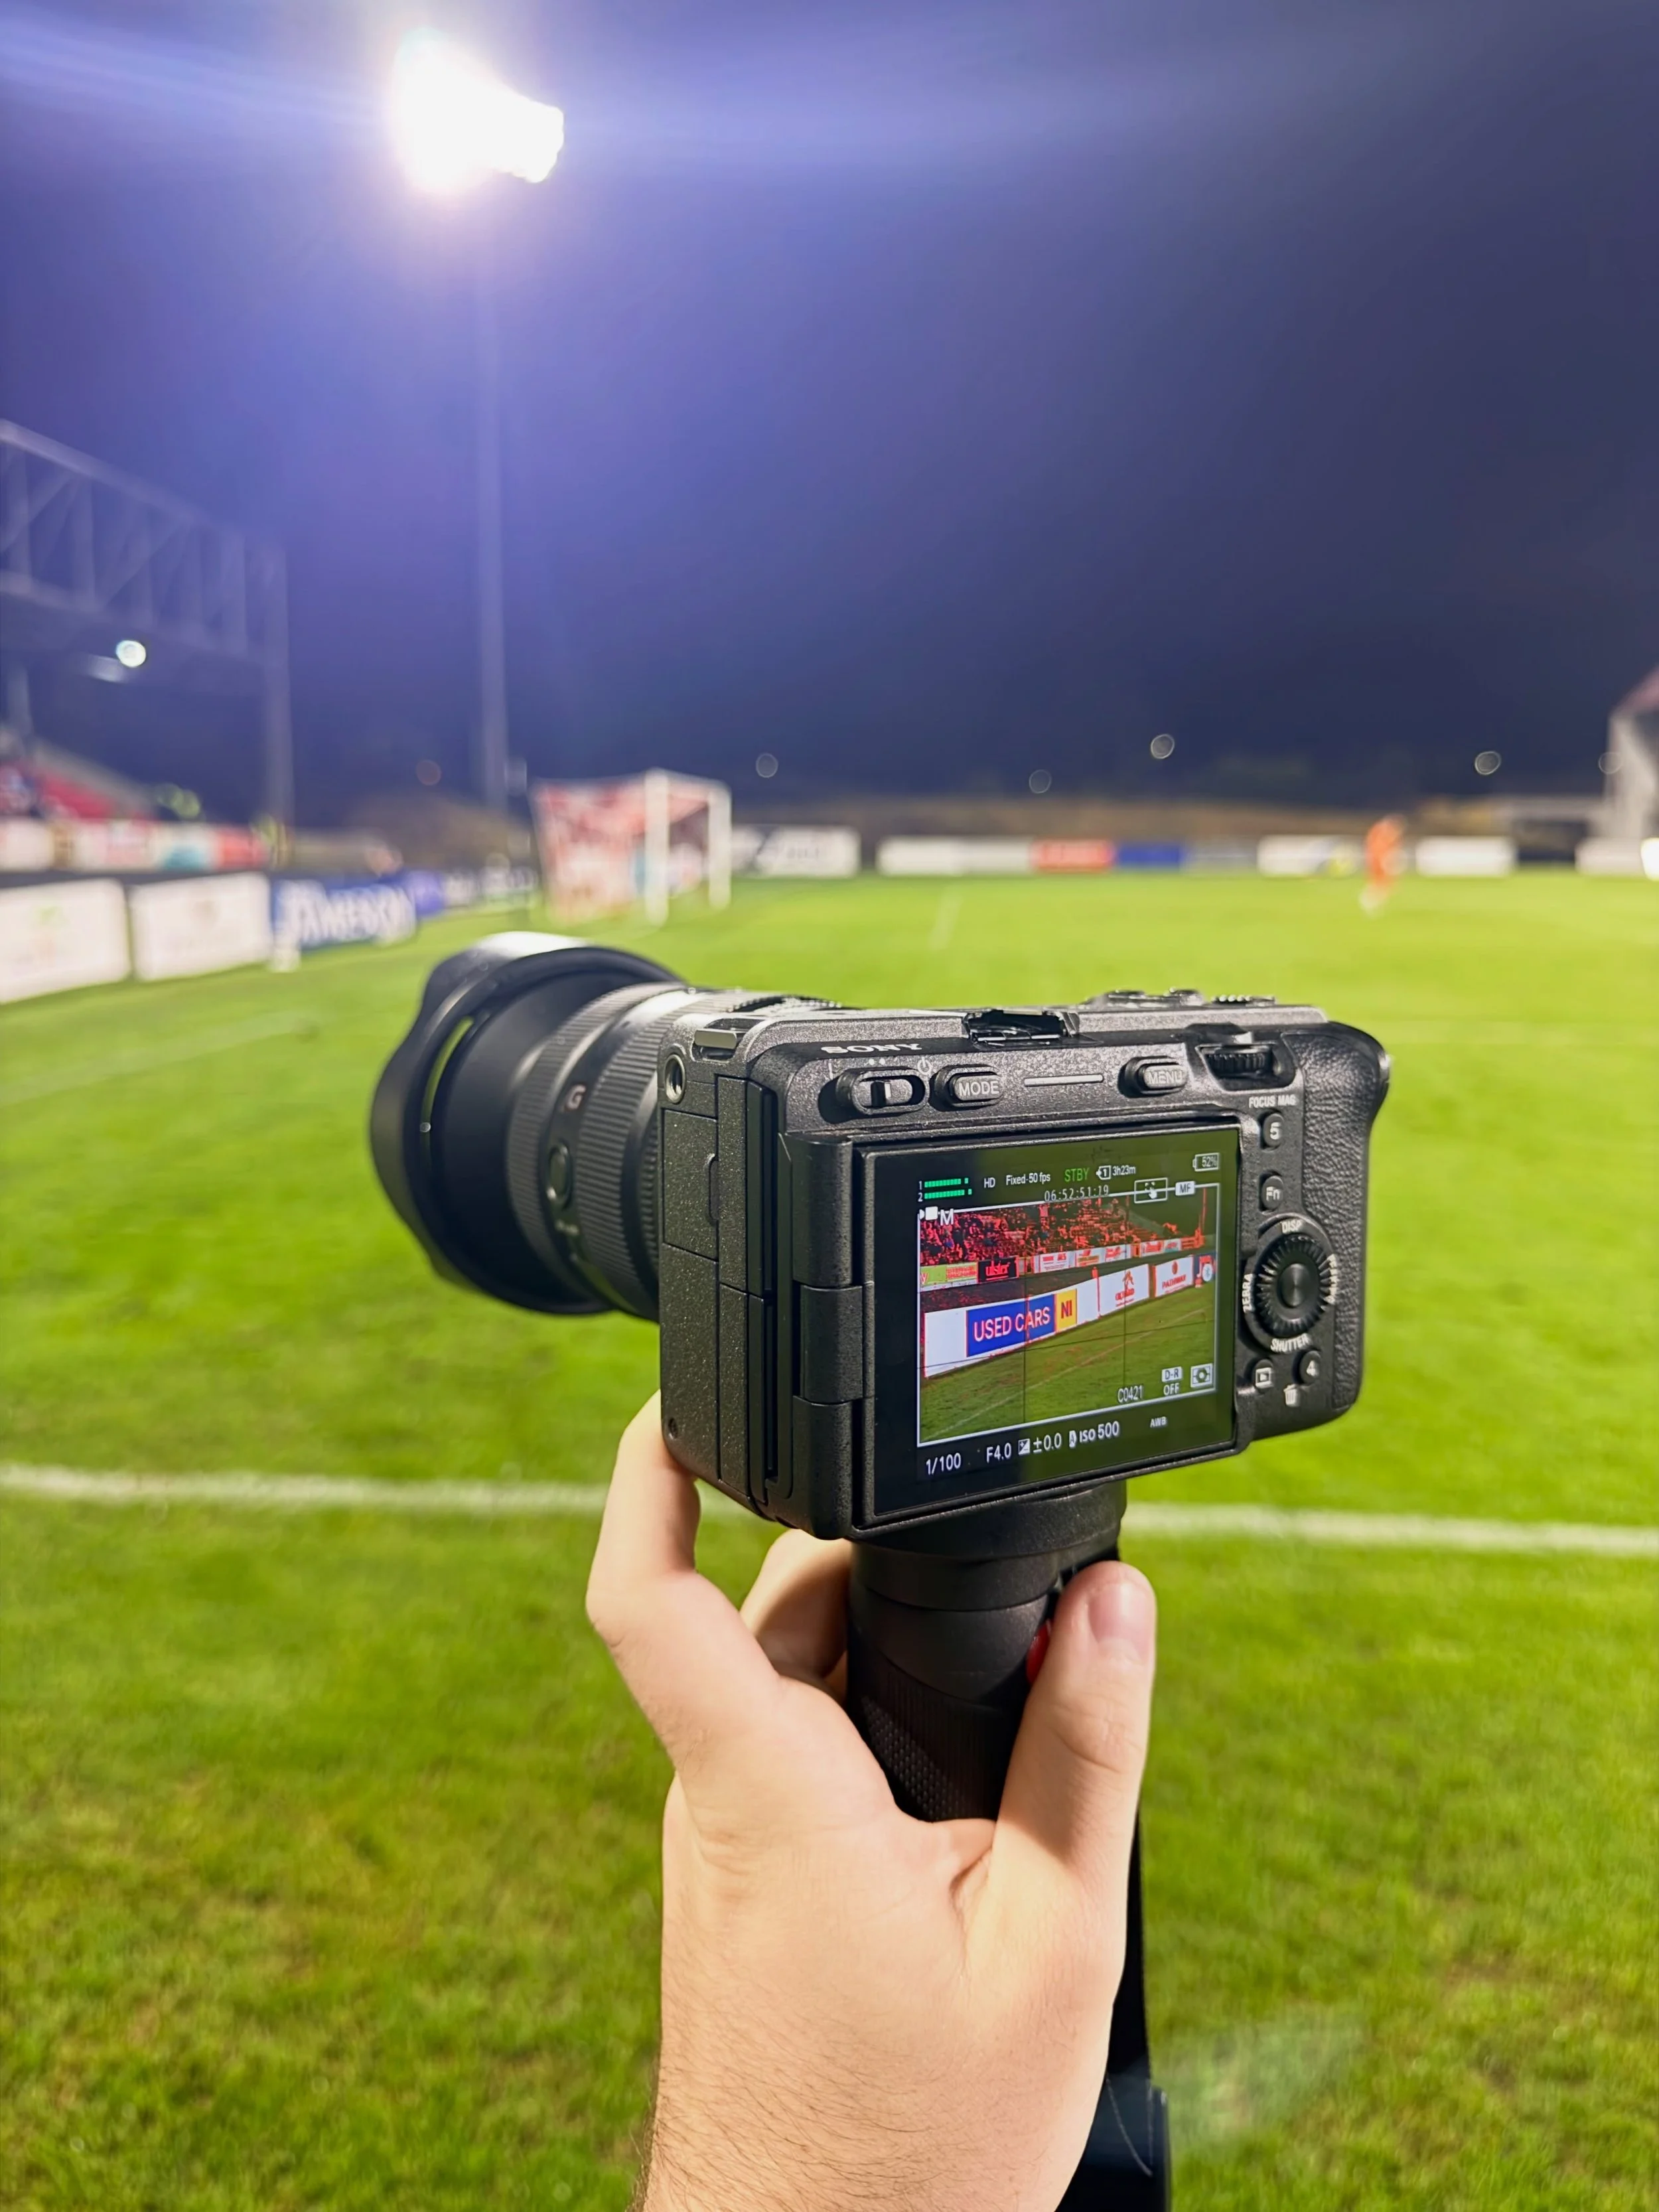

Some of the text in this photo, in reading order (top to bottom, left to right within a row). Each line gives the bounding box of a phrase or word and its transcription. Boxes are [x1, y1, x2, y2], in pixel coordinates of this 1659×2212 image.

[821, 1043, 922, 1054] SONY
[1147, 1071, 1183, 1084] MENU
[958, 1080, 1000, 1096] MODE
[566, 1084, 587, 1110] G
[1248, 1094, 1296, 1109] FOCUS MAG
[1269, 1122, 1281, 1140] 5
[1201, 1155, 1218, 1167] 52%
[1039, 1172, 1051, 1185] fps
[1064, 1167, 1090, 1183] STBY
[1112, 1165, 1137, 1176] 3h23m
[983, 1177, 995, 1189] HD
[1179, 1183, 1192, 1193] MF
[1044, 1185, 1110, 1202] 06:52:51:19
[1265, 1186, 1280, 1201] Fn
[940, 1209, 954, 1226] M
[1281, 1219, 1302, 1233] DISP
[1242, 1273, 1255, 1313] ZEBRA
[974, 1299, 1073, 1343] USED CARS NI
[1270, 1333, 1311, 1353] SHUTTER
[1164, 1368, 1180, 1380] D-R
[1306, 1361, 1319, 1377] 4
[1117, 1385, 1144, 1403] C0421
[1163, 1382, 1180, 1396] OFF
[1098, 1420, 1120, 1440] 500
[1149, 1416, 1168, 1428] AWB
[1033, 1432, 1062, 1453] ±0.0
[986, 1442, 1012, 1463] F4.0
[926, 1452, 962, 1475] 1/100
